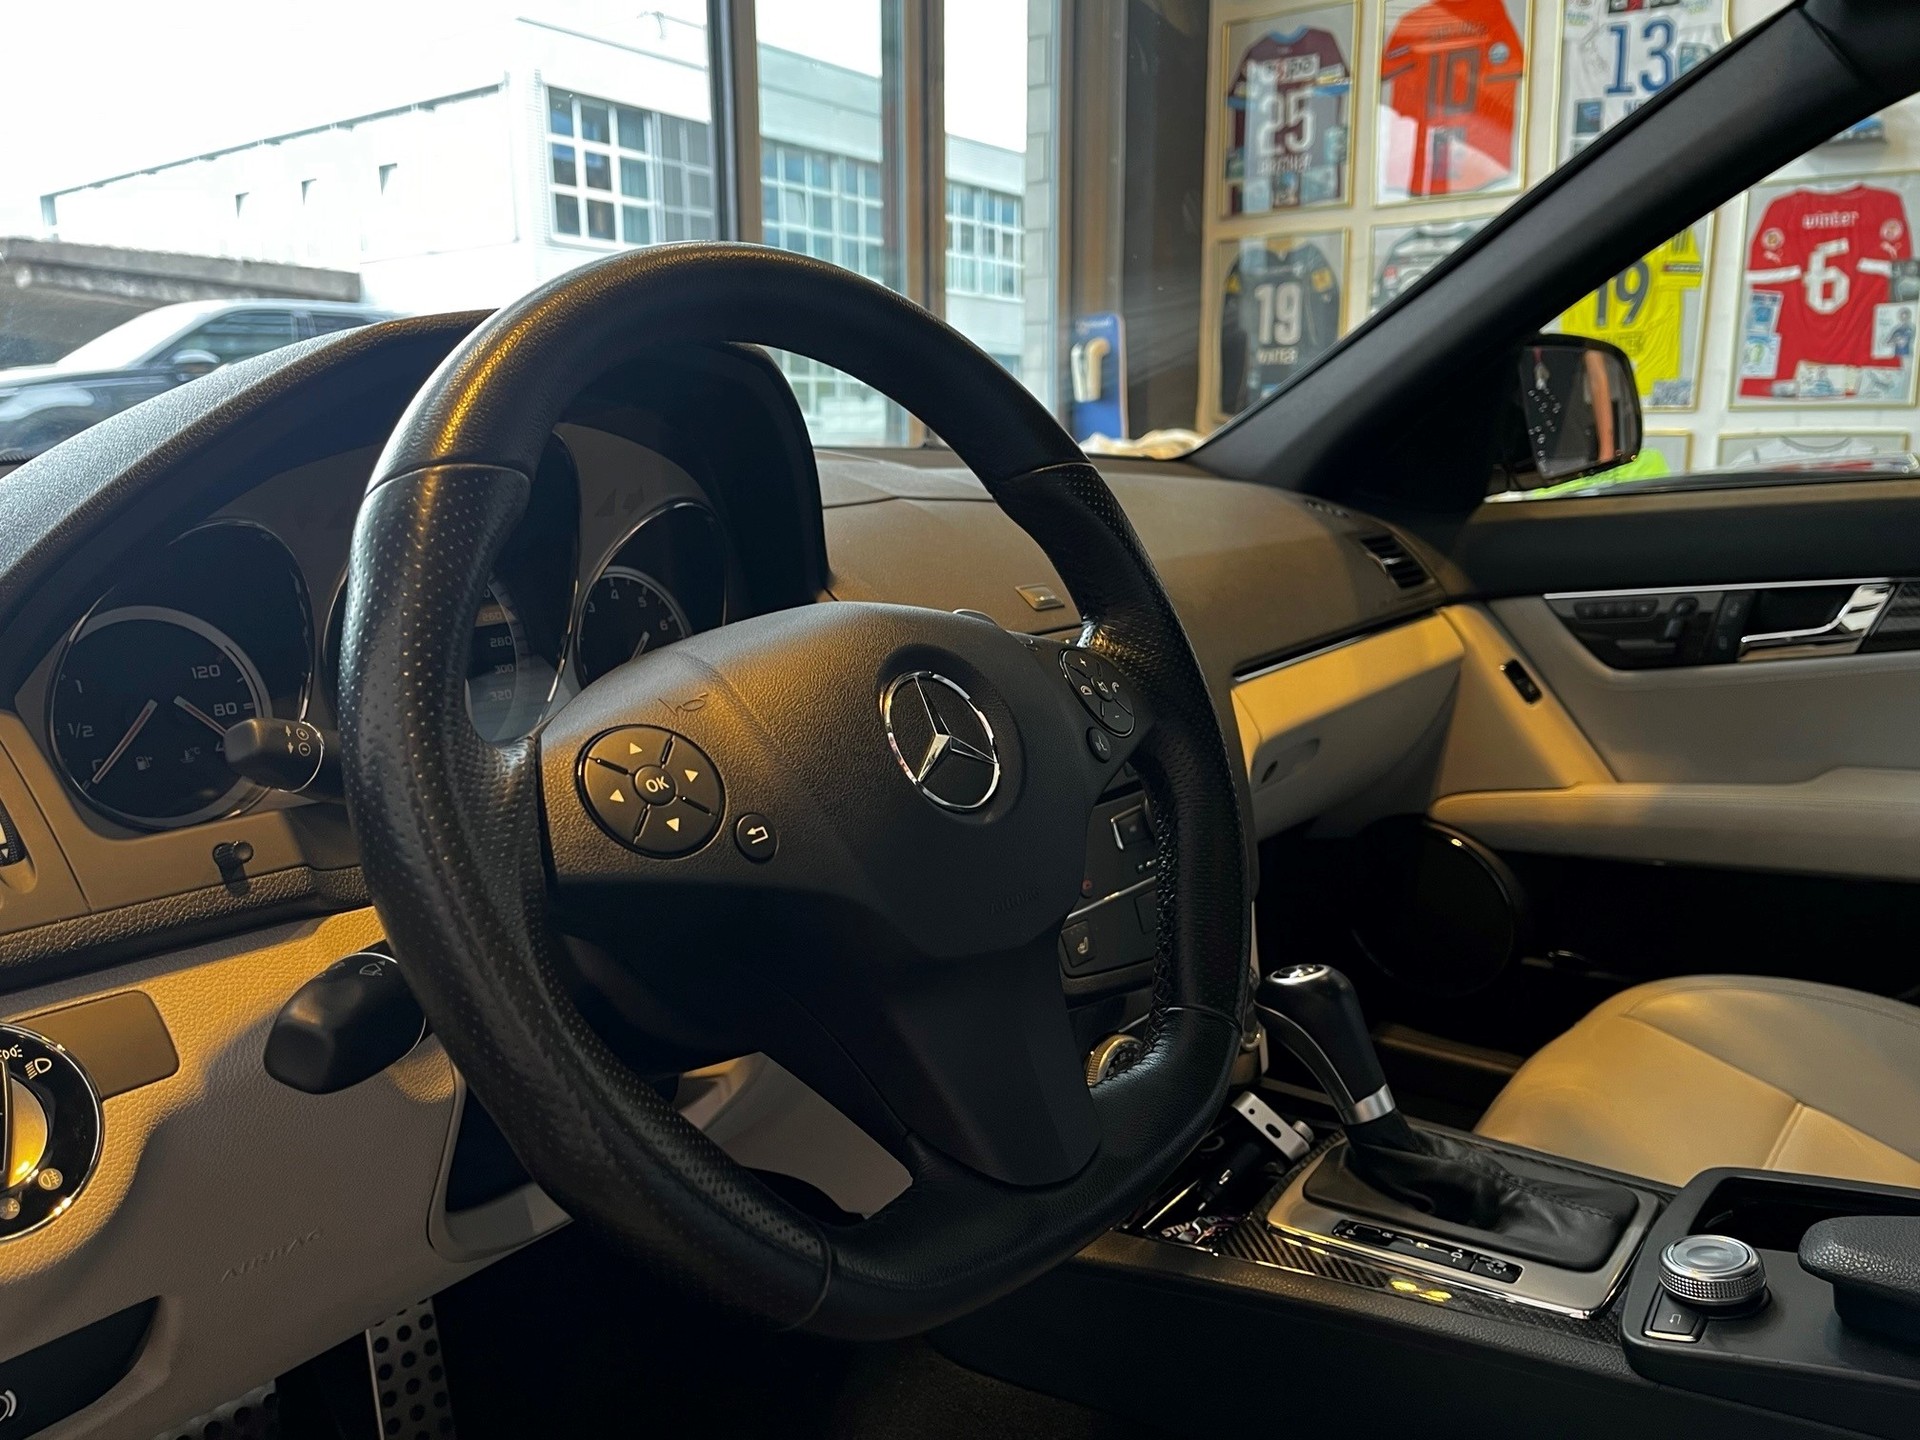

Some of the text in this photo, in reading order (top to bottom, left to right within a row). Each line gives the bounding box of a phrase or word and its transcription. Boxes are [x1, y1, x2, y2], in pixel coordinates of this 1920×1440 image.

[1426, 46, 1481, 117] 10
[1605, 19, 1674, 94] 13
[1258, 88, 1317, 155] 25
[1596, 259, 1649, 328] 19
[1803, 237, 1851, 315] 6
[1254, 281, 1303, 345] 19
[191, 664, 222, 680] 120
[68, 722, 95, 739] 1/2
[214, 702, 239, 717] 80
[645, 776, 670, 793] OK
